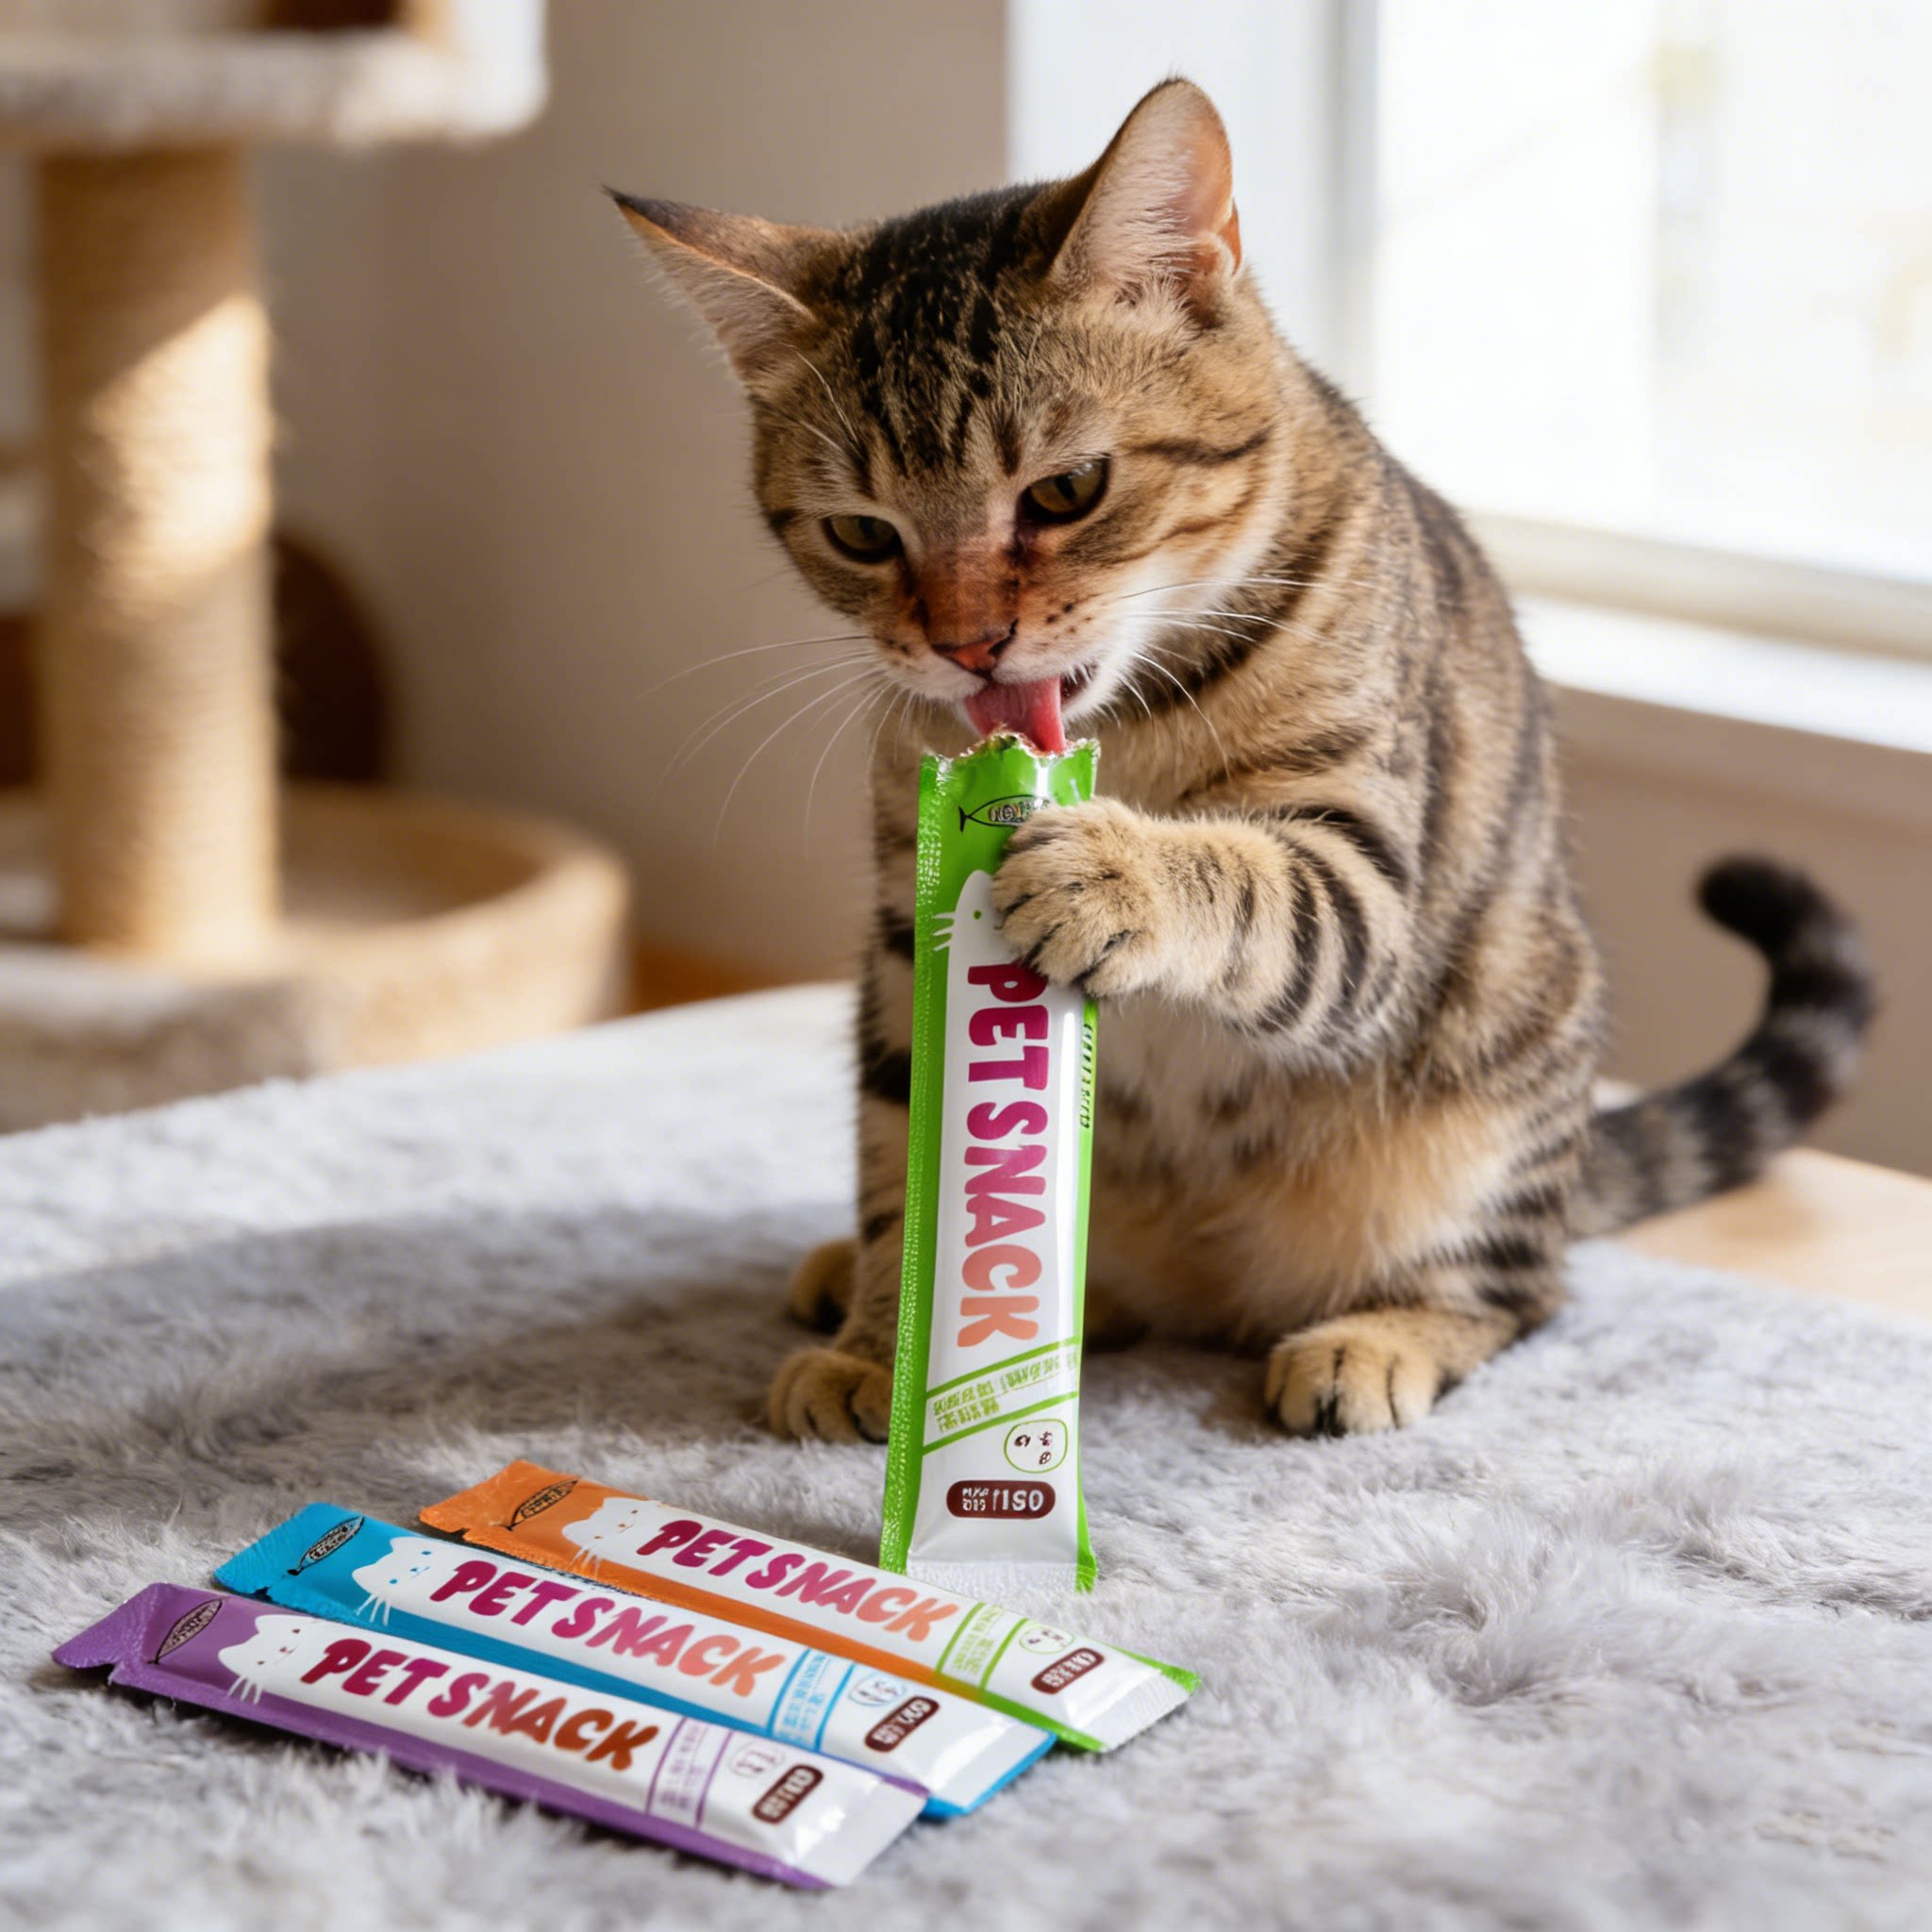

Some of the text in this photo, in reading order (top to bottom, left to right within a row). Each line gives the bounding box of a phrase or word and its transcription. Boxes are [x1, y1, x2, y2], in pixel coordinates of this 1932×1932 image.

[957, 1100, 1049, 1348] SNACK
[551, 1597, 786, 1696] SNACK
[744, 1553, 959, 1642] SNACK
[426, 1673, 659, 1772] SNACK
